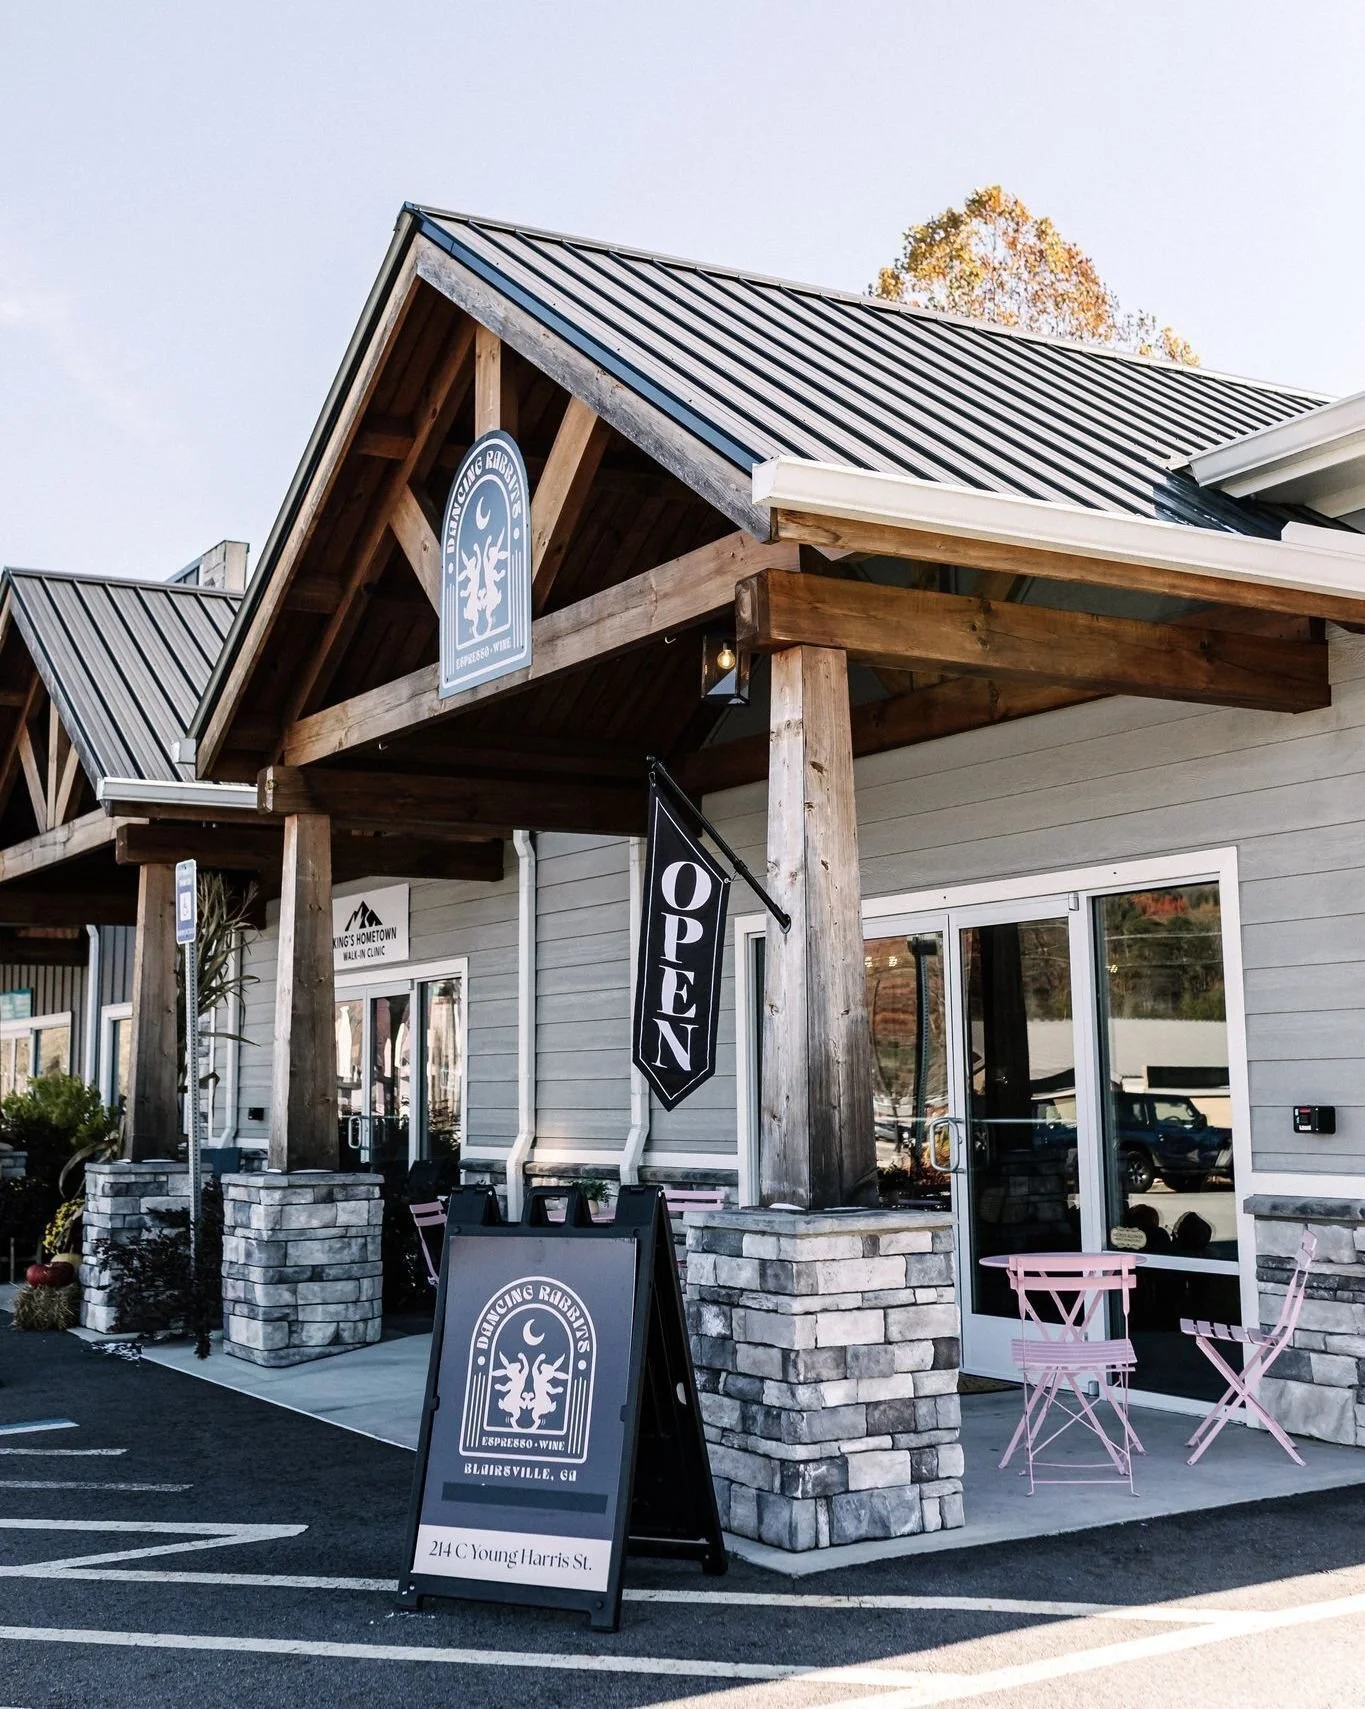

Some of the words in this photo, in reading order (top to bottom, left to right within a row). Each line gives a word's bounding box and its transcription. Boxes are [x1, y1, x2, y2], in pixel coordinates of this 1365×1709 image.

[447, 456, 482, 553] DANCING
[486, 451, 521, 518] RABBITS
[455, 646, 489, 670] ESPRESSO
[493, 637, 511, 653] WINE
[333, 935, 354, 949] KING'S
[357, 927, 397, 945] HOMETOWN
[343, 949, 365, 961] WALK-IN
[367, 945, 385, 958] CLINIC
[651, 861, 712, 1071] OPEN
[476, 1285, 533, 1350] DANCING
[539, 1285, 590, 1353] RABBITS
[481, 1436, 533, 1449] ESPRESSO
[539, 1440, 565, 1451] WINE
[464, 1463, 554, 1481] BLAIRSVILLE,
[560, 1469, 577, 1482] GA
[429, 1540, 451, 1558] 214
[455, 1543, 468, 1560] C
[471, 1544, 519, 1570] Young
[521, 1548, 569, 1569] Harris
[572, 1553, 593, 1571] St.
